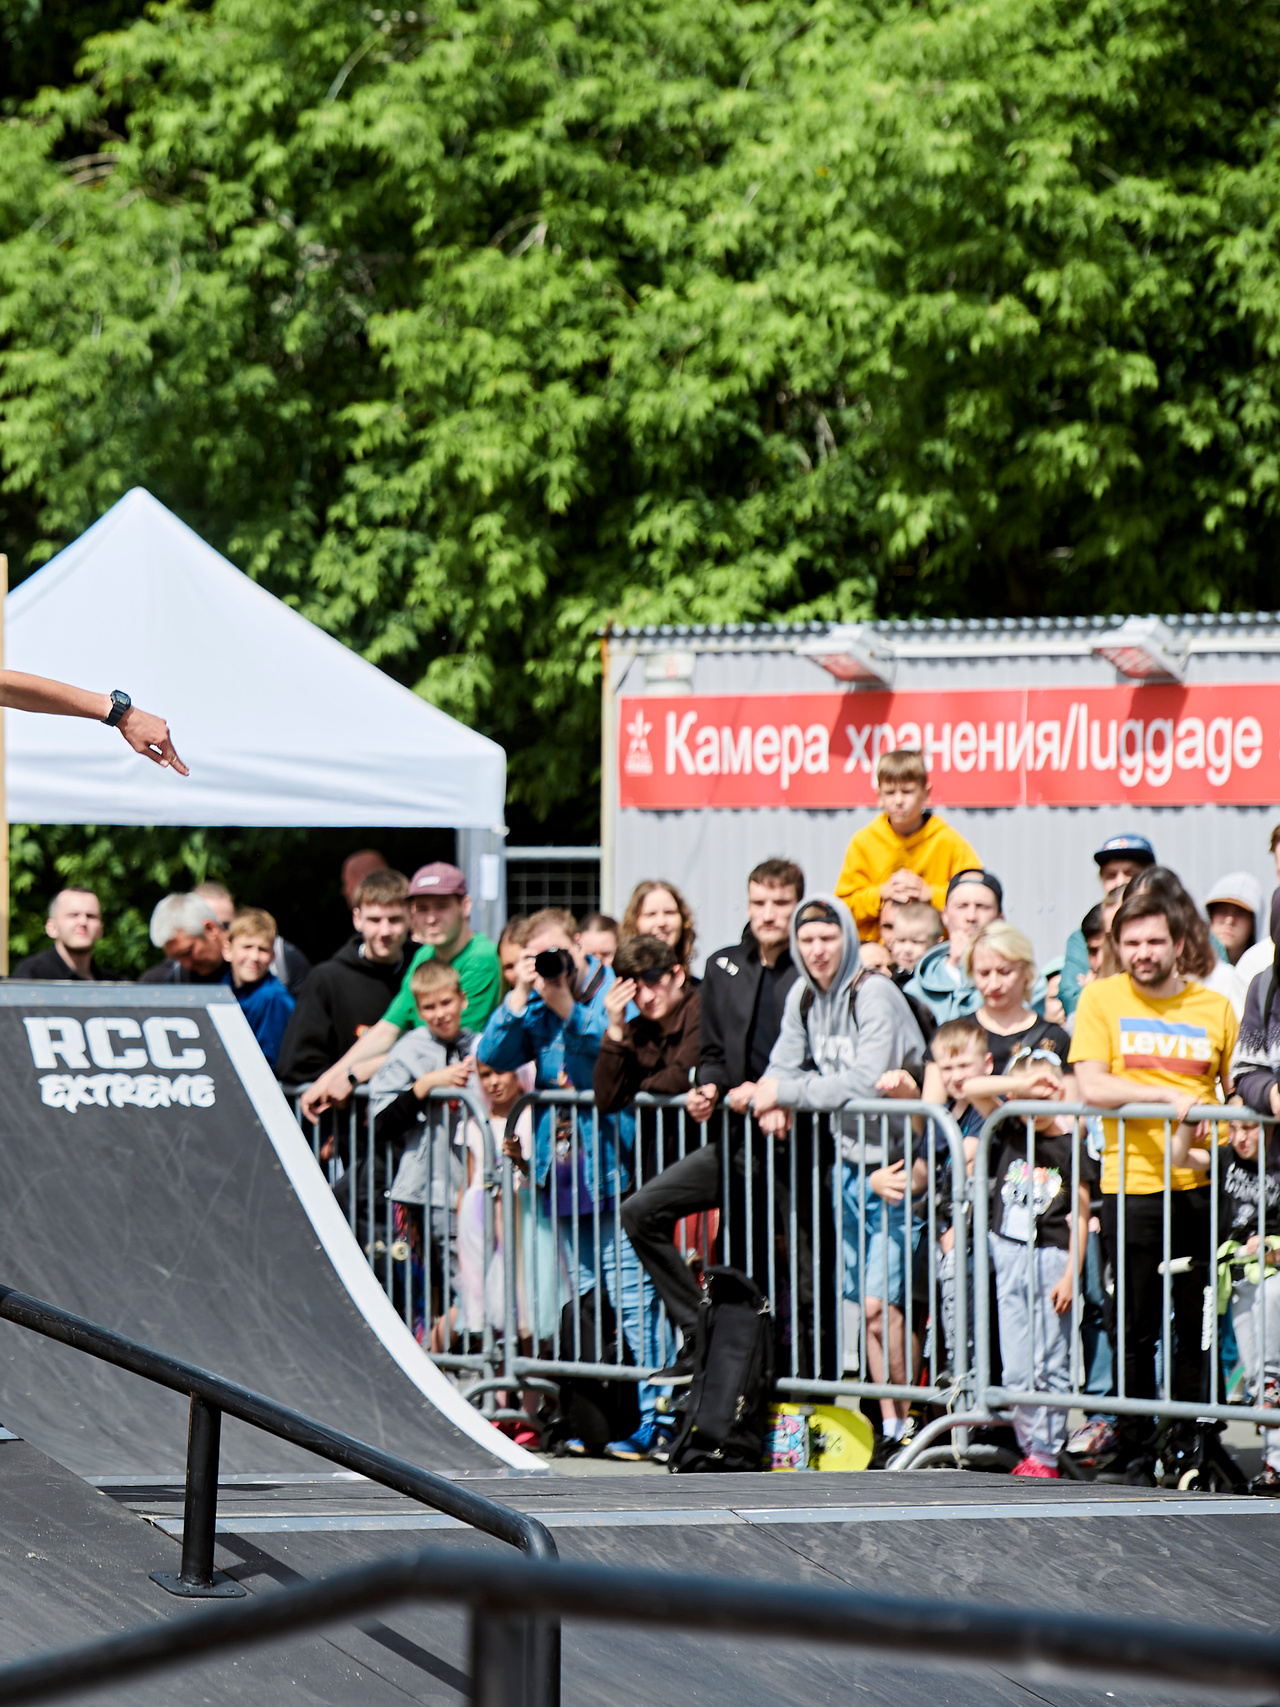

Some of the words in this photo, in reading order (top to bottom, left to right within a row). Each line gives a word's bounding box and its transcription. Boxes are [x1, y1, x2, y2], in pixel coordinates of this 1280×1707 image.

[665, 710, 830, 790] Камера
[23, 1016, 206, 1069] RCC
[38, 1072, 216, 1114] EXTREME
